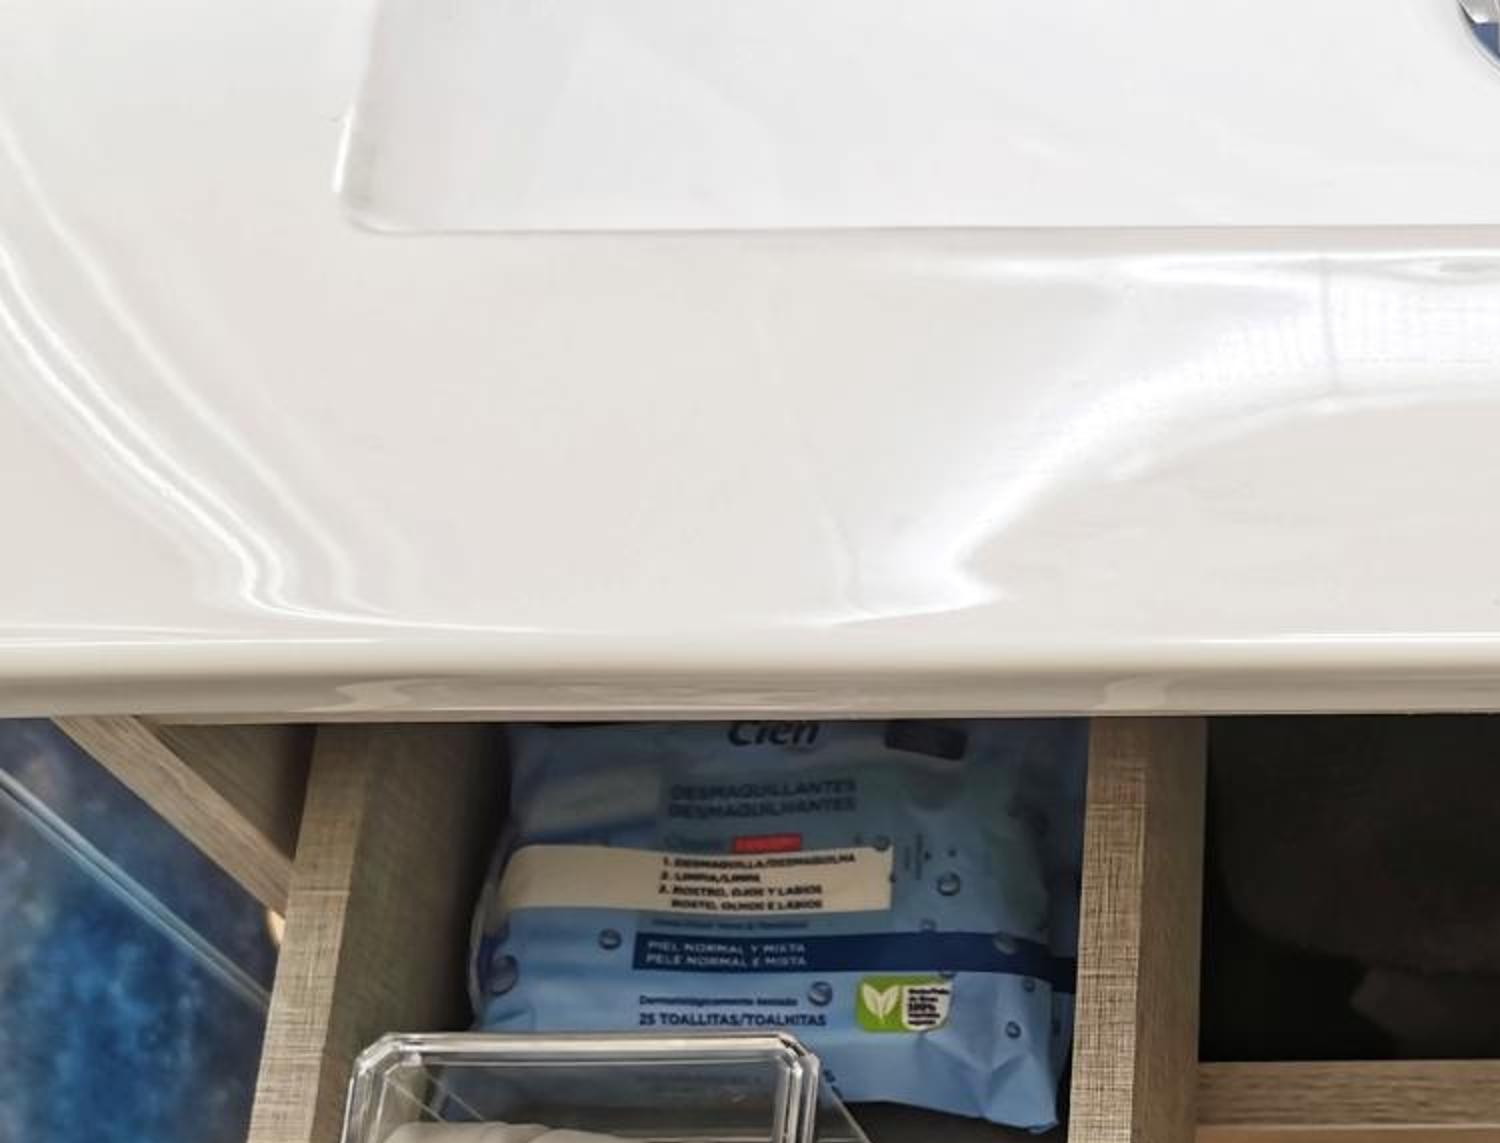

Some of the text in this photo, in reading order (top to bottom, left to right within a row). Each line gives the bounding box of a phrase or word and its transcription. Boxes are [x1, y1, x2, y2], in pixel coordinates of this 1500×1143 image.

[729, 720, 820, 746] Cien
[671, 779, 856, 800] DESMAQUILLANTES
[684, 943, 744, 954] NORMAL
[686, 955, 747, 966] NORMAL
[640, 1013, 656, 1026] 25
